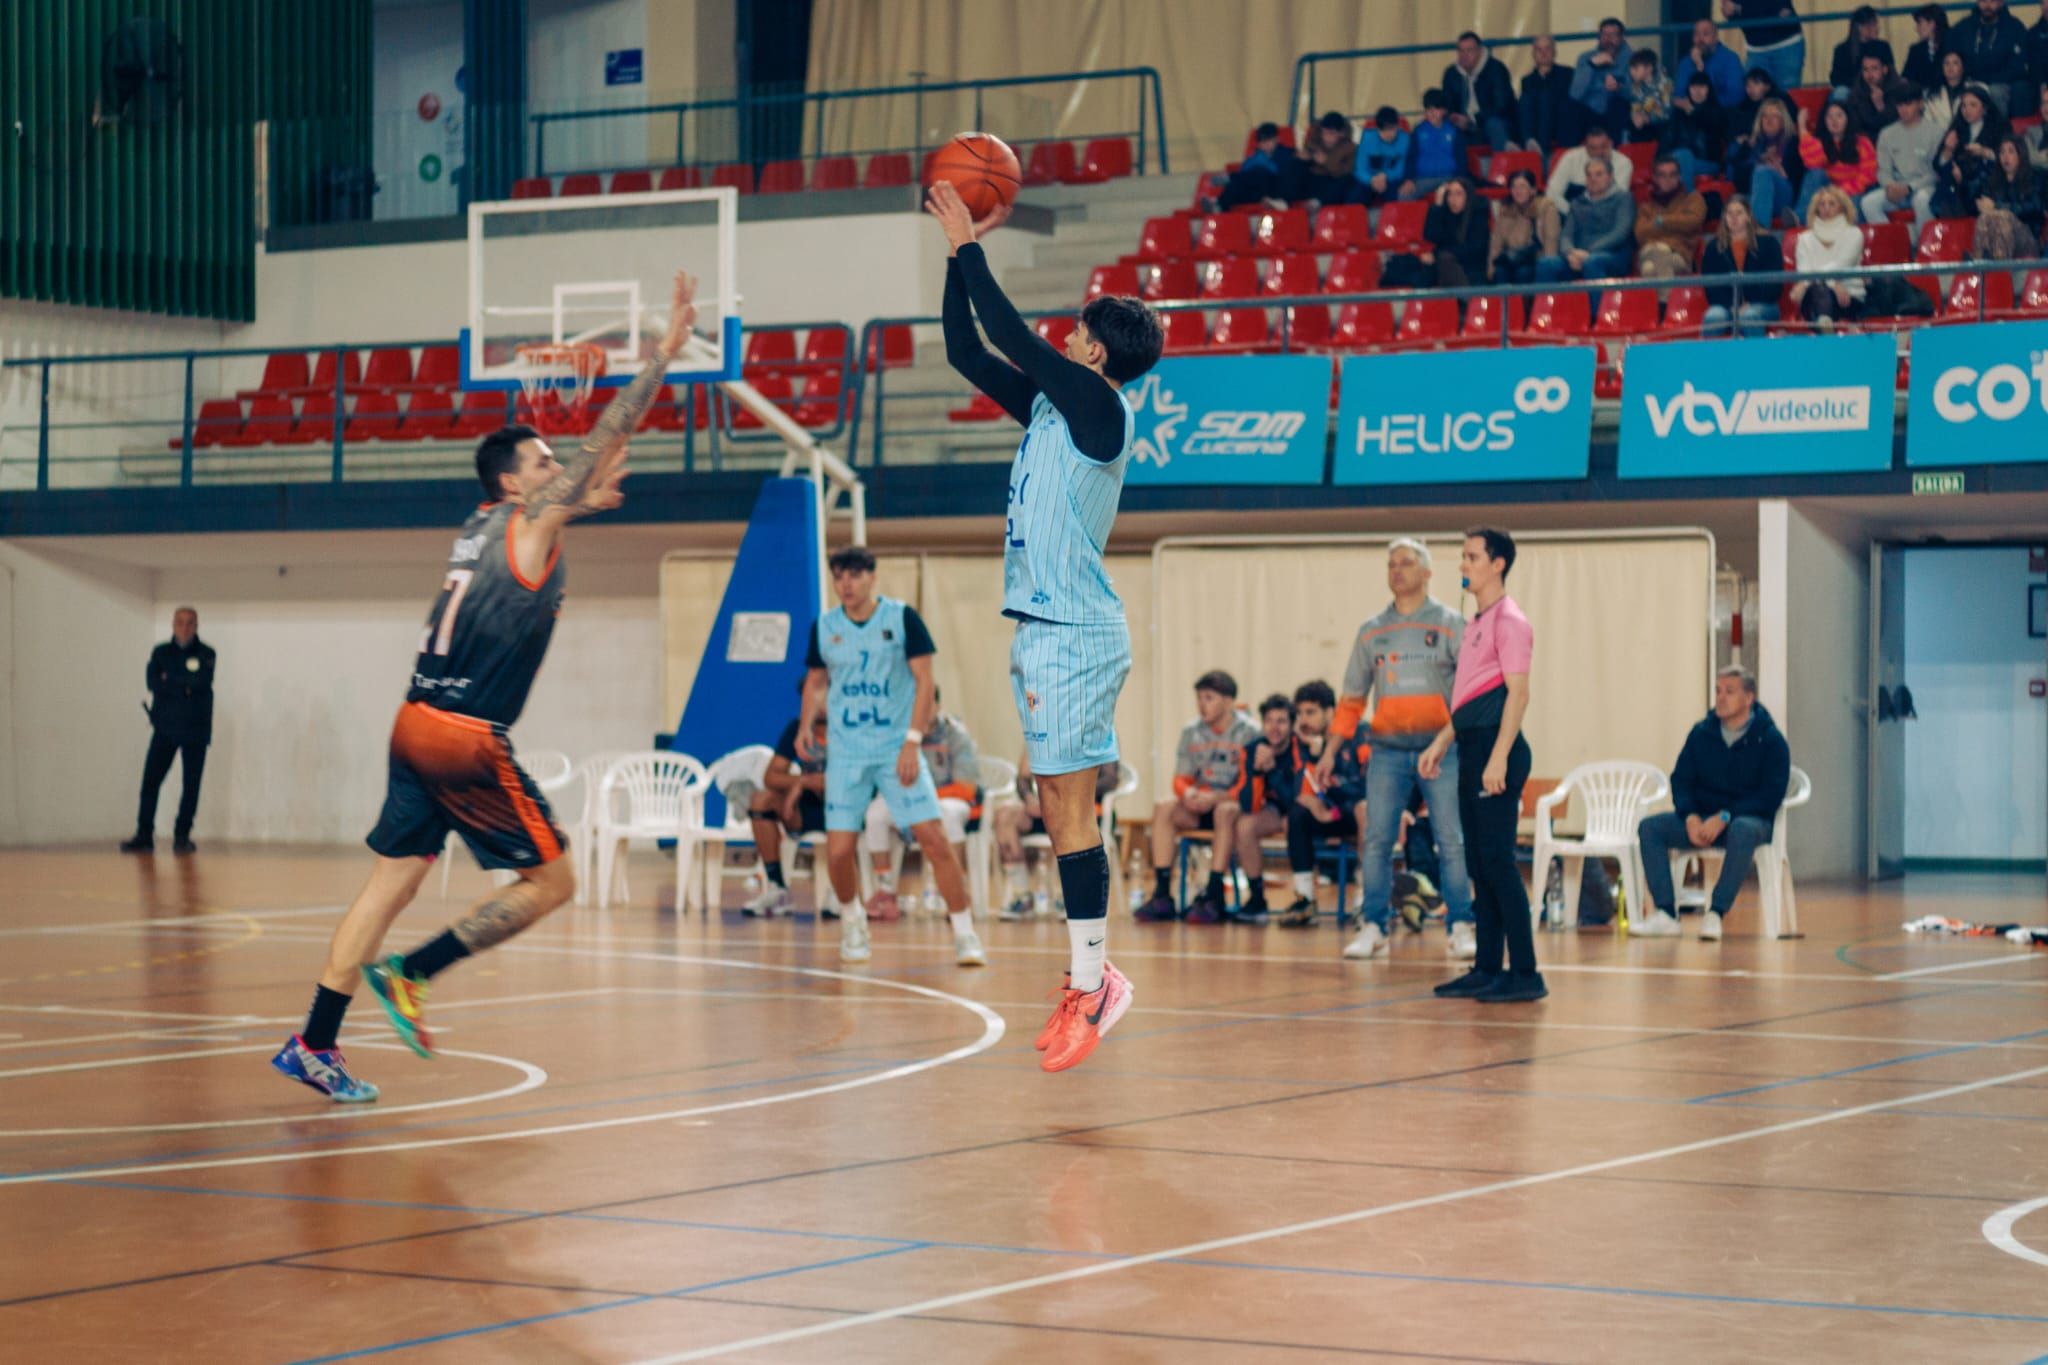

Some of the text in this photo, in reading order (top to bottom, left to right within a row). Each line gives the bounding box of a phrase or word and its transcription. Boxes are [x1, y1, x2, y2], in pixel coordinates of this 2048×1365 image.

[1356, 410, 1516, 455] HELIOS
[1645, 380, 1859, 438] vtv videoluc
